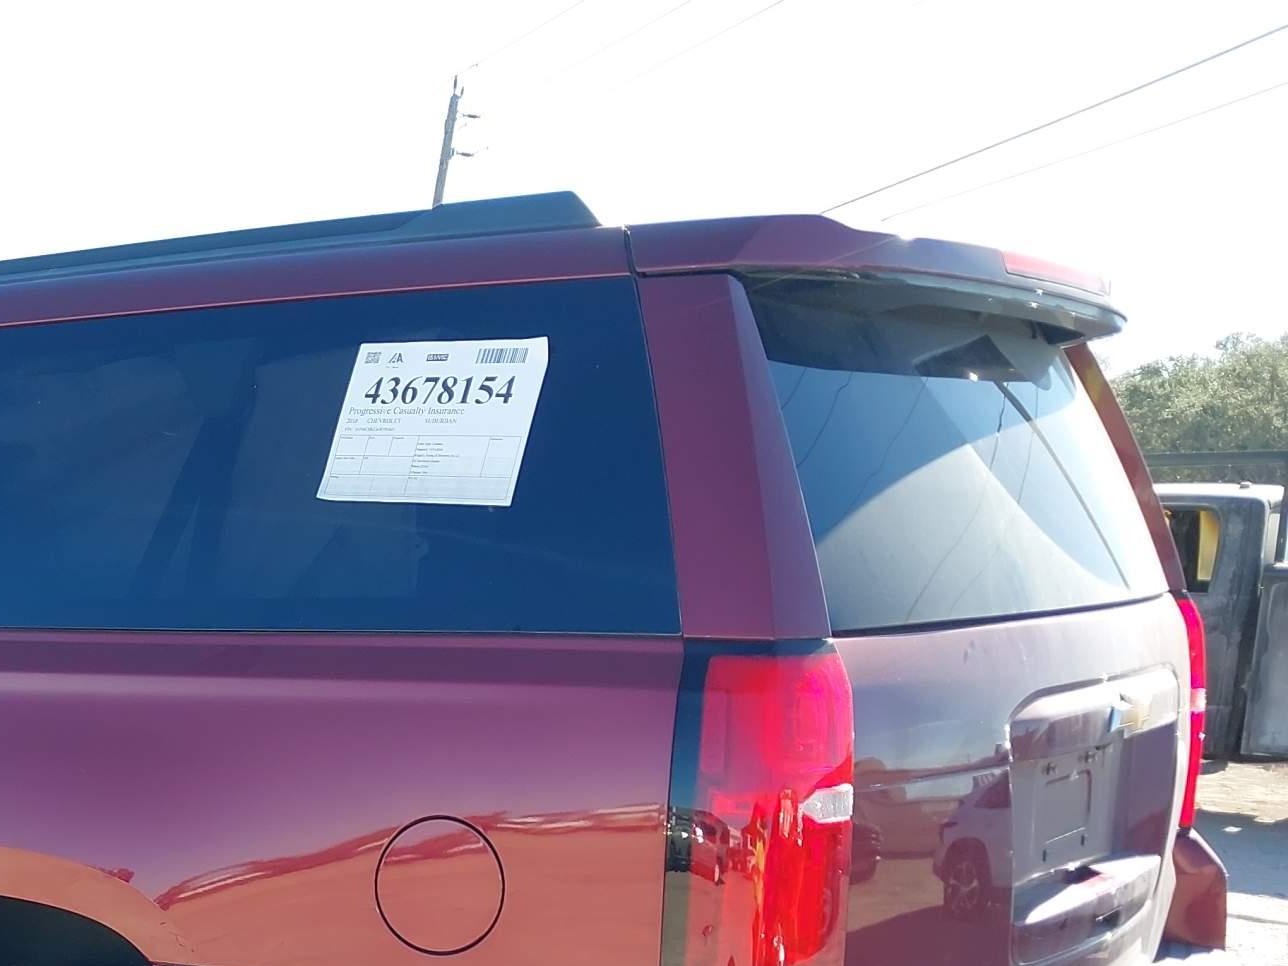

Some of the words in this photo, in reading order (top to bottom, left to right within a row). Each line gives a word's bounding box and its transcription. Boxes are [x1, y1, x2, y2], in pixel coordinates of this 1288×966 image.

[364, 375, 517, 405] 43678154
[348, 406, 392, 417] Progressive
[393, 406, 425, 417] Casualty
[427, 407, 465, 416] Insurance
